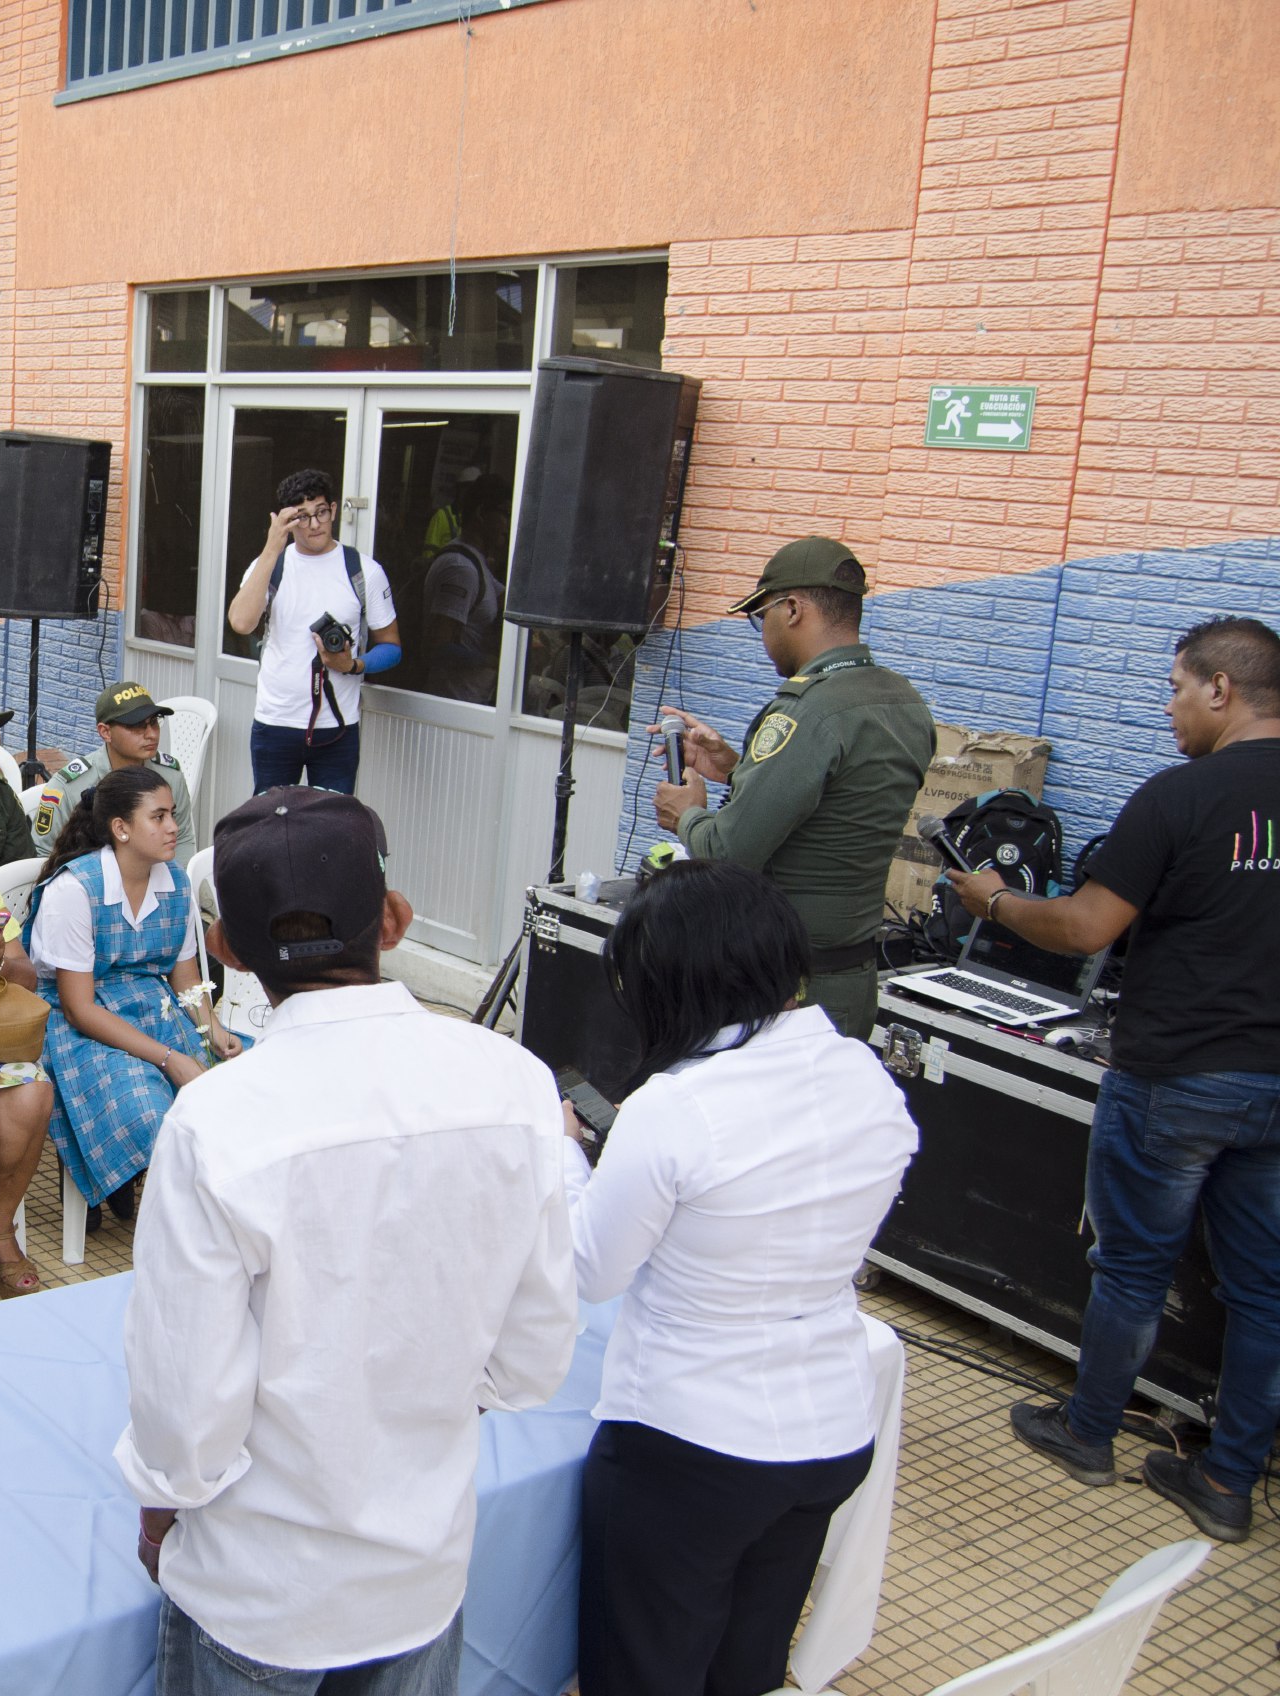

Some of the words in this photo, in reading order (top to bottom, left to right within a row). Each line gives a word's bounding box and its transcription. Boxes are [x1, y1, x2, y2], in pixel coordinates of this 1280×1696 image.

[989, 394, 1008, 402] RUTA
[1010, 394, 1020, 402] DE
[980, 402, 1026, 412] EVACUACIÓN
[822, 660, 856, 673] NACIONAL
[947, 769, 994, 783] PROCESSOR
[924, 787, 969, 801] LVP605S
[1230, 858, 1280, 872] PROD
